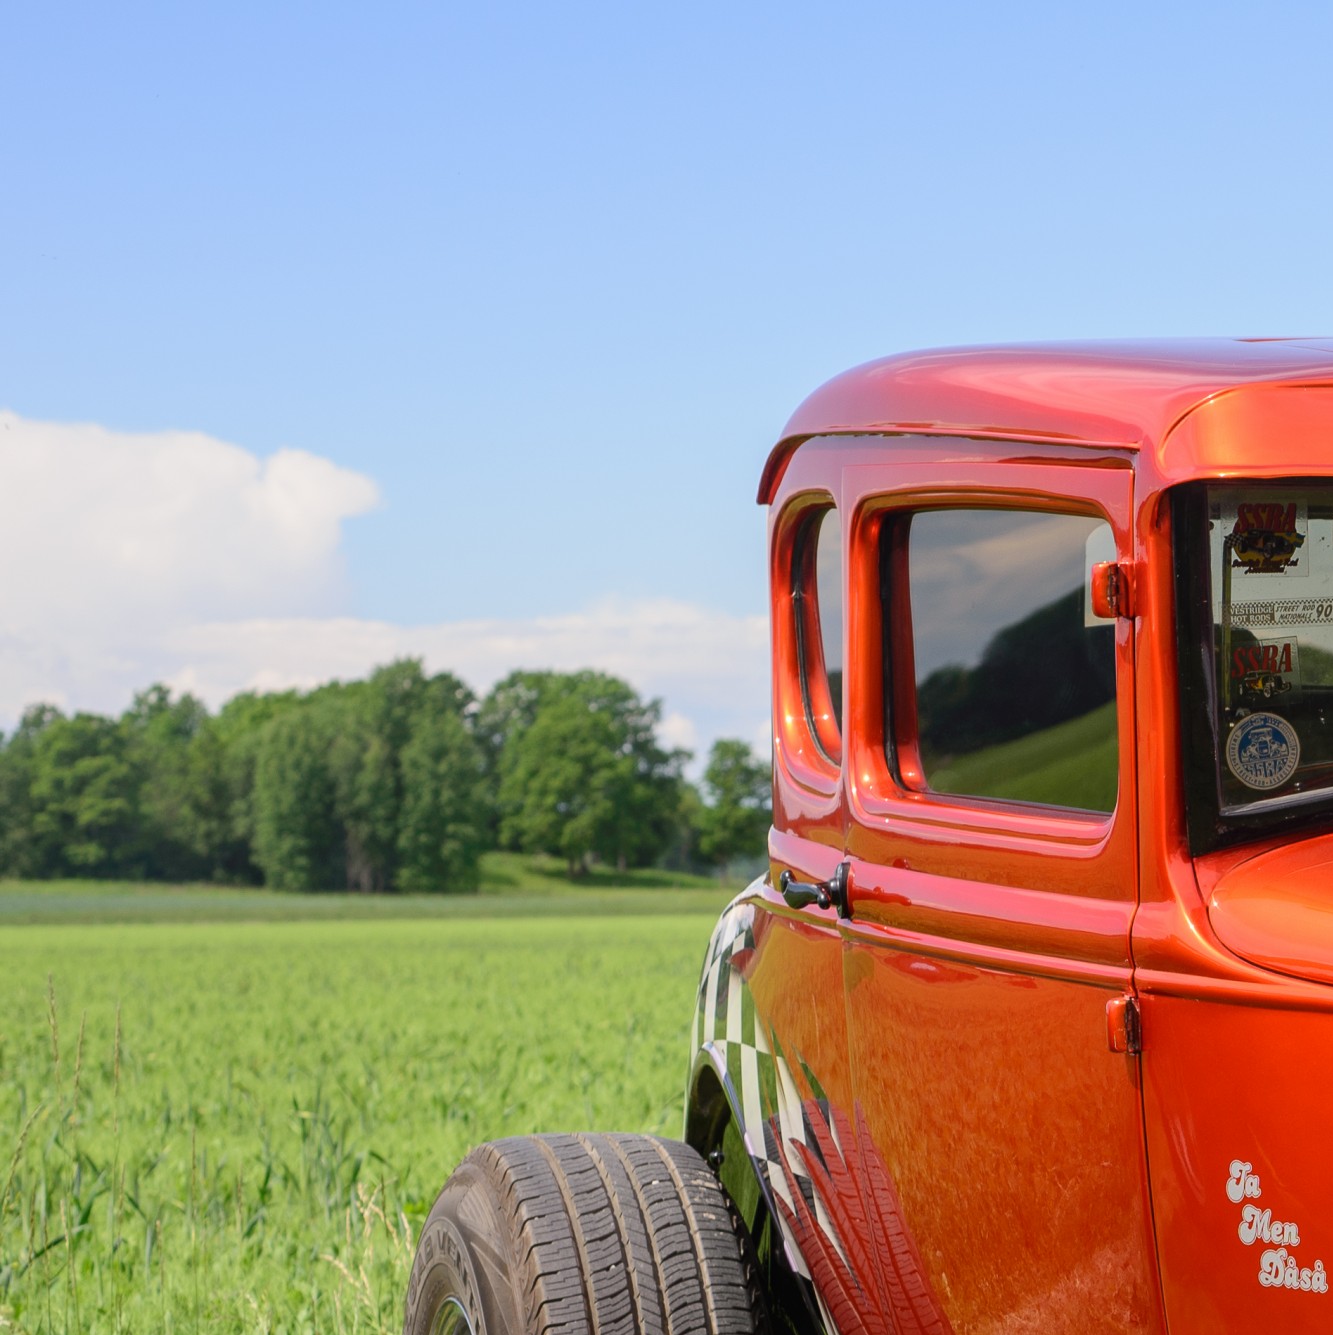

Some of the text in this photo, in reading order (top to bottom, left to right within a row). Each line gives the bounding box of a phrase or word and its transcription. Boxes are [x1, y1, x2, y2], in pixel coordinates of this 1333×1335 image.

[1232, 503, 1297, 533] SSRA
[1250, 614, 1271, 622] RODS
[1275, 604, 1300, 612] STREET
[1279, 612, 1313, 620] NATIONALS
[1316, 603, 1333, 619] 90
[1231, 643, 1293, 679] SSRA
[1226, 1159, 1262, 1204] Ja
[1238, 1203, 1301, 1247] Men
[1258, 1247, 1328, 1294] Dåså
